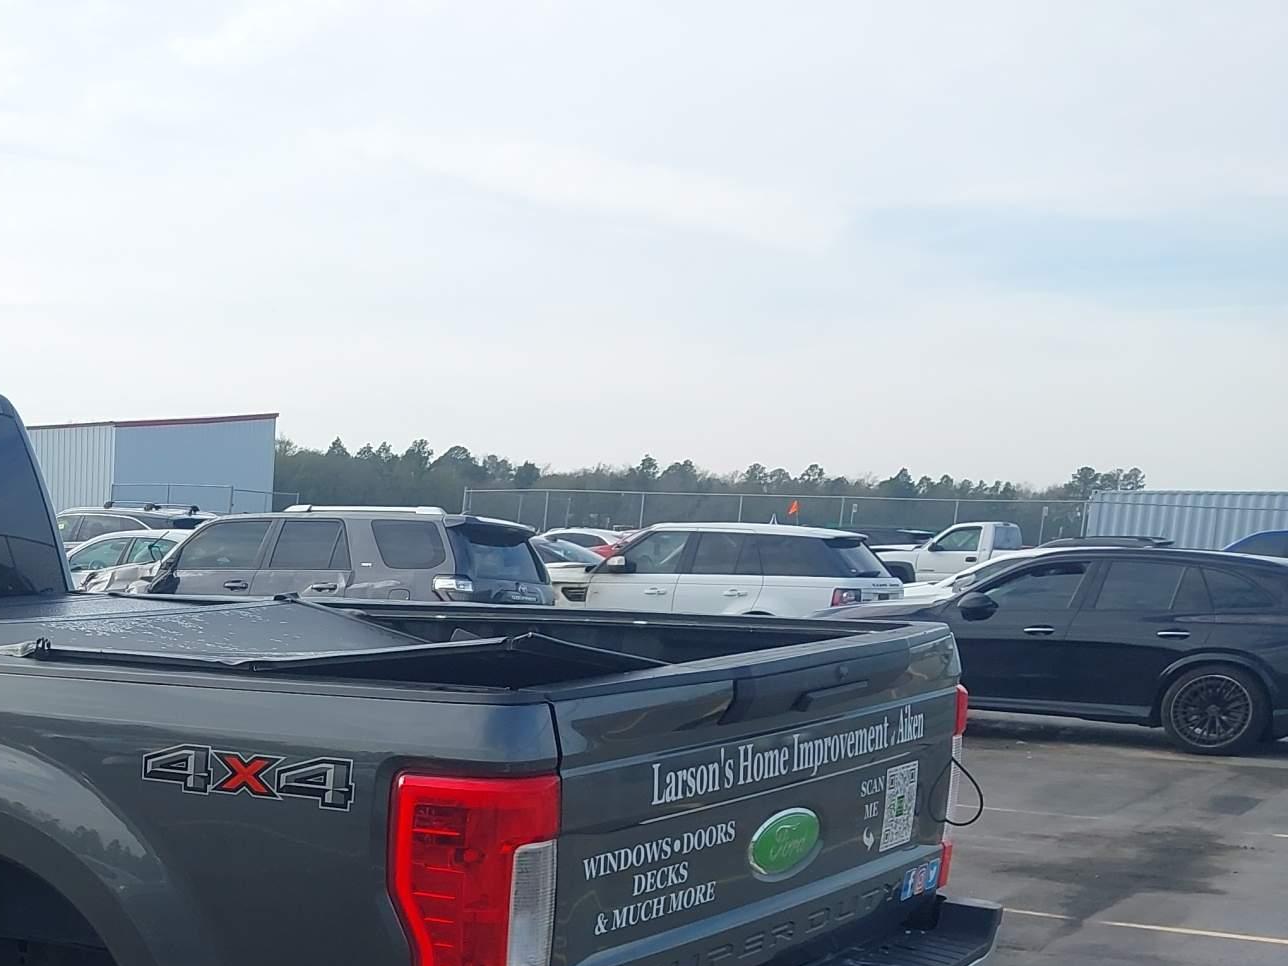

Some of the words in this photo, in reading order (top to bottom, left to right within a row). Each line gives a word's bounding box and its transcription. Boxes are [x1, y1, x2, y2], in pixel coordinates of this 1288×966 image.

[651, 747, 734, 806] Larson's
[737, 743, 789, 786] Home
[791, 715, 890, 777] Improvement
[896, 704, 925, 745] Aiken
[861, 775, 886, 797] SCAN
[863, 801, 880, 820] ME
[768, 821, 809, 861] Ford
[632, 861, 690, 897] DECKS
[594, 912, 609, 936] &
[611, 895, 666, 931] MUCH
[667, 881, 717, 914] MORE
[806, 880, 902, 935] DUTY
